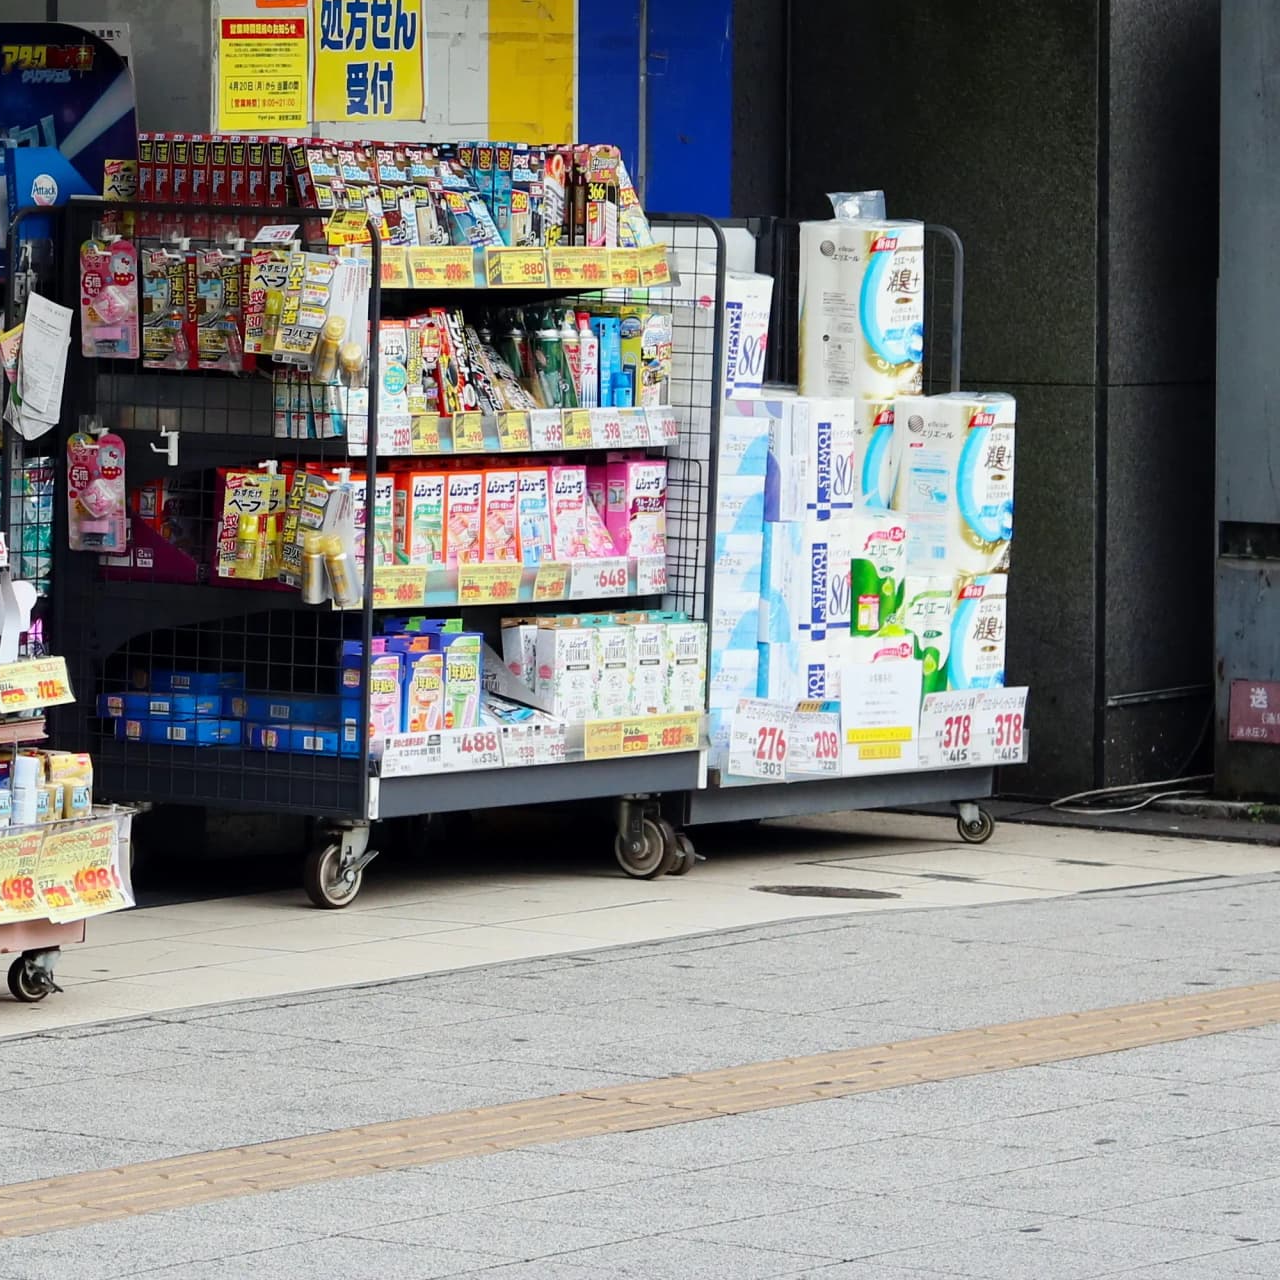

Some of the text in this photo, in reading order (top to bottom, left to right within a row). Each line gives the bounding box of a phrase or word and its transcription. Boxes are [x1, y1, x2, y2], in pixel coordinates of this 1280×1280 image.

[346, 62, 394, 115] 受付
[598, 568, 627, 588] 648
[461, 731, 497, 753] 488
[943, 714, 972, 749] 378
[994, 713, 1022, 747] 378
[757, 727, 786, 761] 276
[814, 731, 839, 759] 208
[949, 748, 968, 763] 415
[1001, 746, 1020, 761] 415
[762, 762, 782, 776] 303
